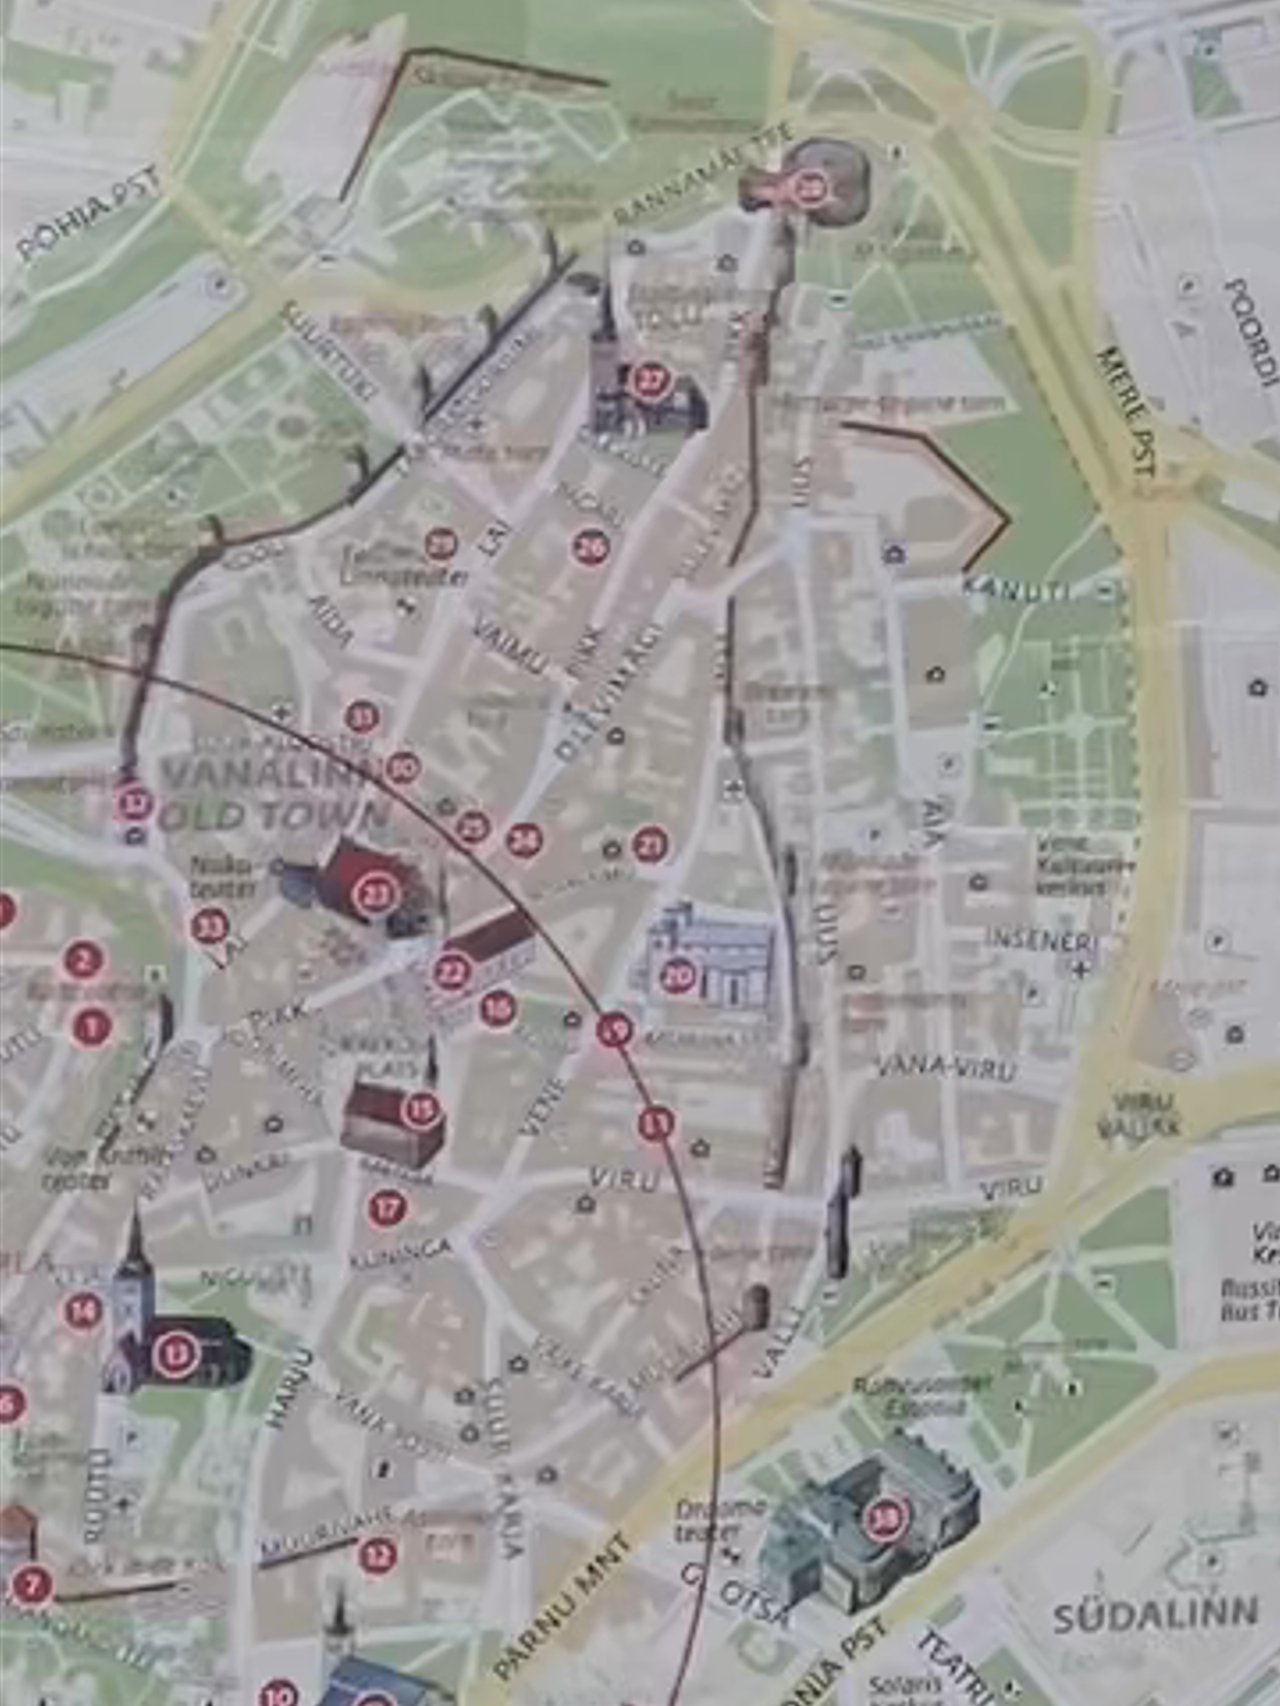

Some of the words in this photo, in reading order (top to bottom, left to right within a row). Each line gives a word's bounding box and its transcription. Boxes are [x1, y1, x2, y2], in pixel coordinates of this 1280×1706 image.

[1225, 278, 1280, 388] POORDI
[1097, 345, 1149, 427] MERE
[1134, 429, 1157, 478] PST
[157, 800, 256, 831] OLD
[261, 800, 388, 831] TOWN
[874, 1056, 1018, 1082] VANA-VIRU
[979, 1176, 1044, 1201] VIRU
[1221, 1303, 1260, 1323] Bus
[265, 1347, 315, 1430] HARJU
[718, 1579, 793, 1630] OTSA
[1053, 1598, 1259, 1630] SÜDALINN
[840, 1612, 890, 1662] PST
